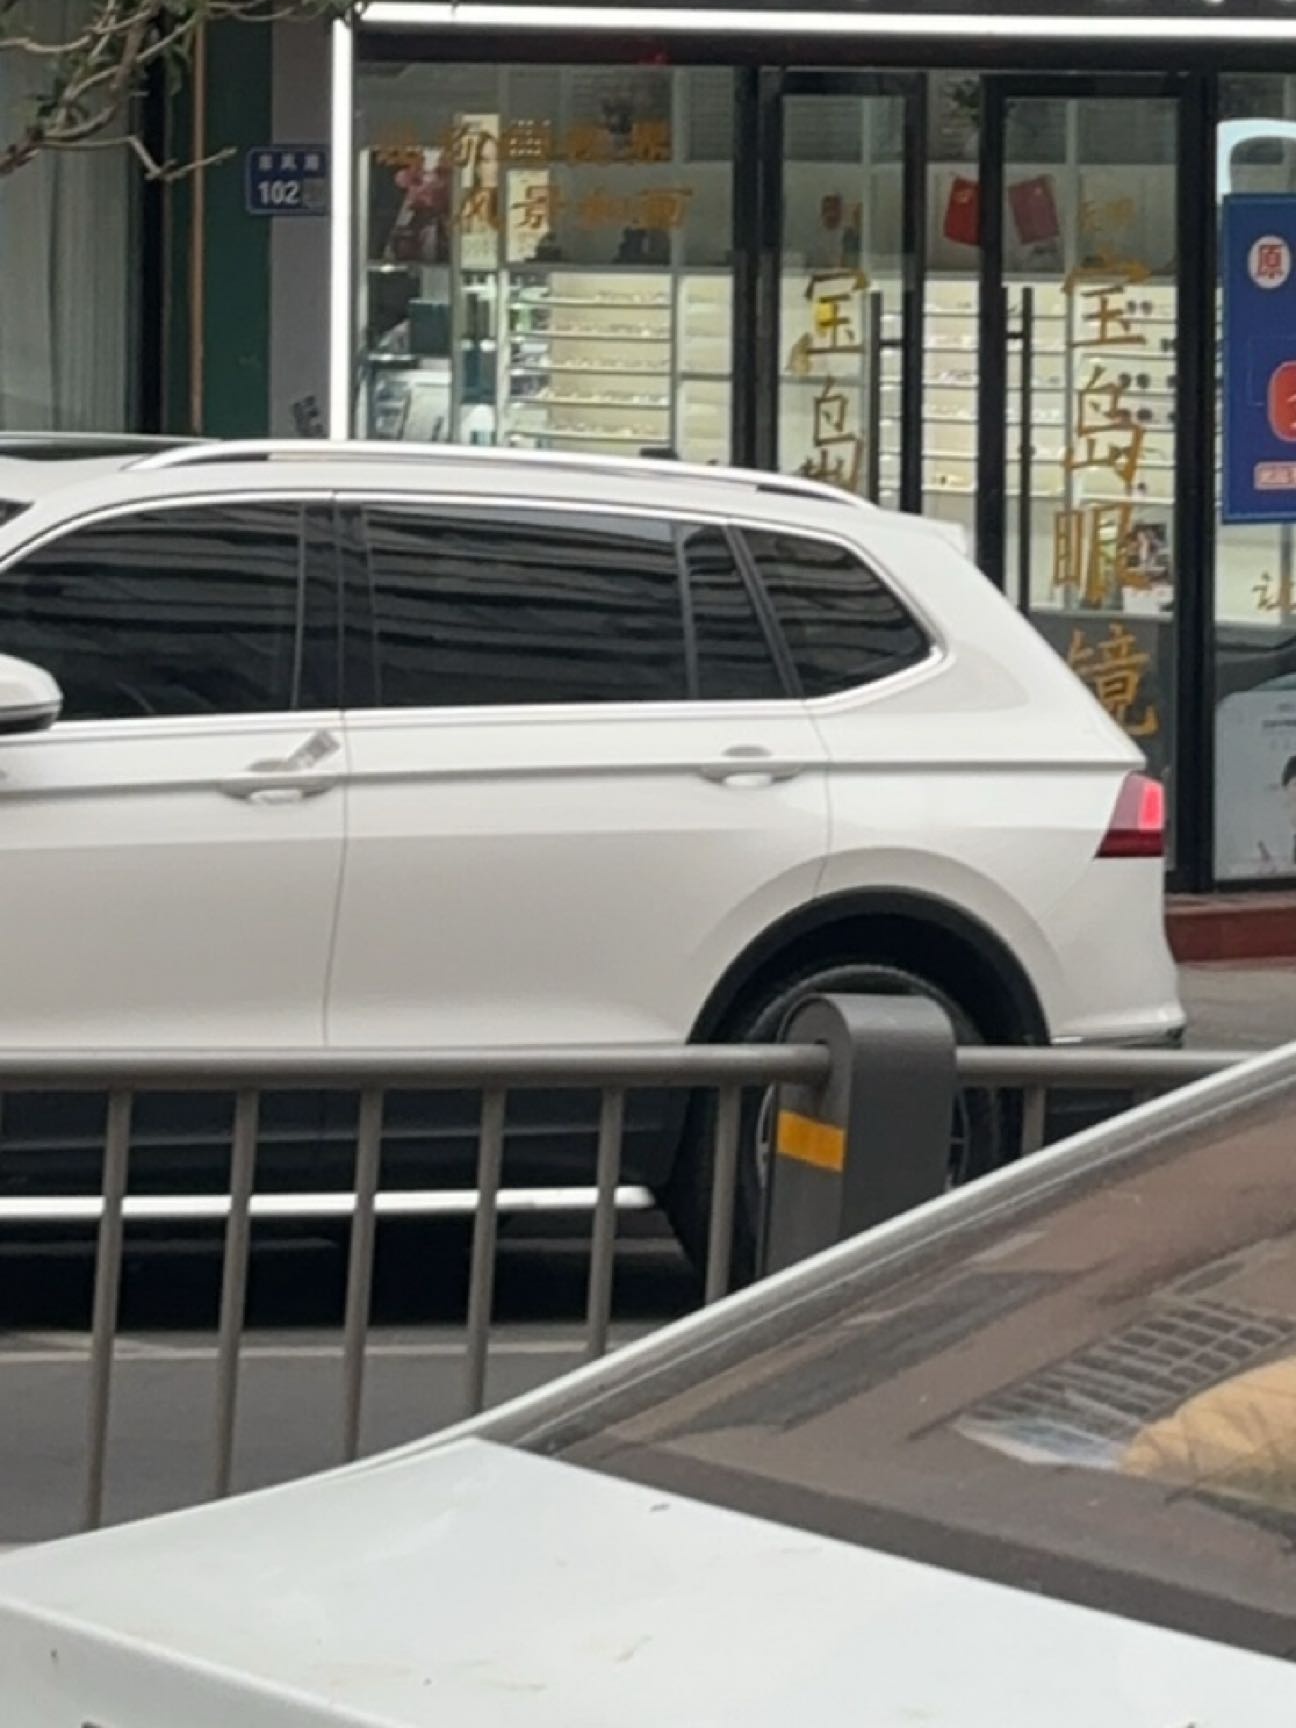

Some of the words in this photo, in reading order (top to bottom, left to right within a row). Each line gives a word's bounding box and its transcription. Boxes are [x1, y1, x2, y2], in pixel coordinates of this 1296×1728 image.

[257, 180, 299, 205] 102
[1050, 250, 1162, 739] 宝岛眼镜
